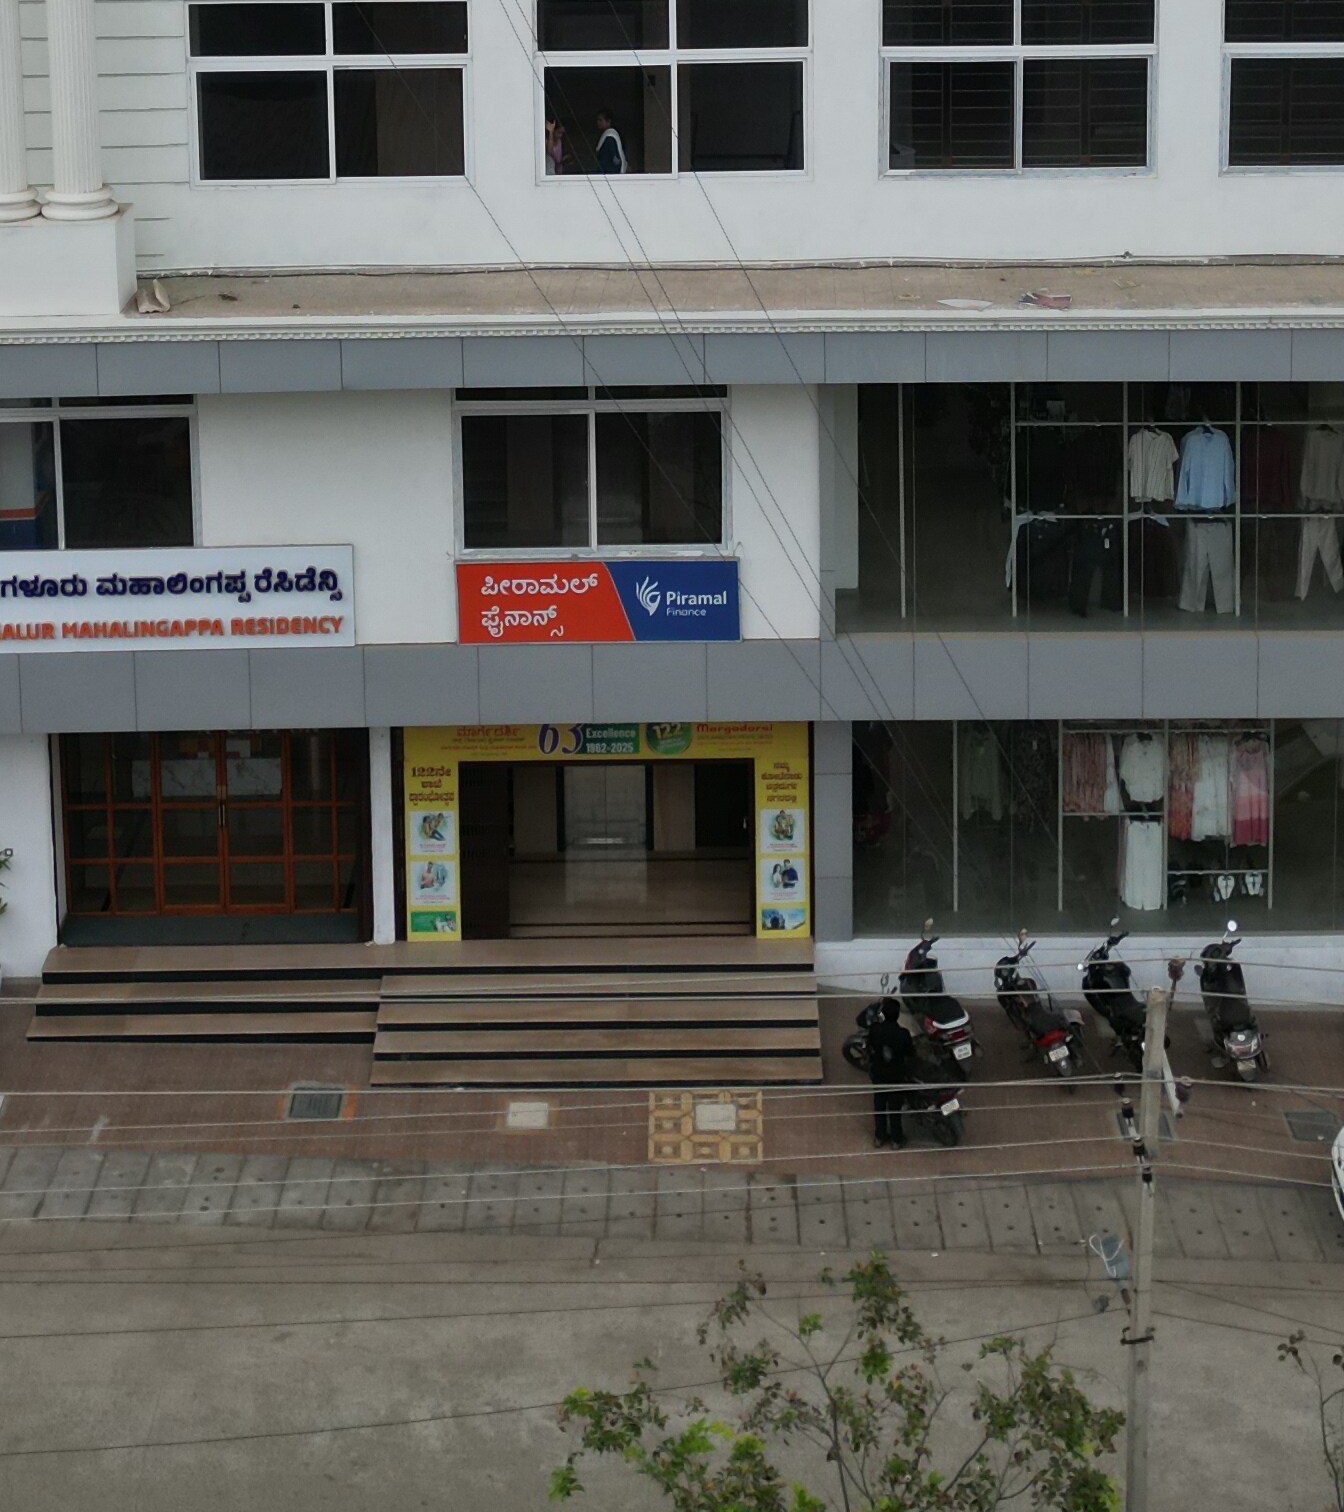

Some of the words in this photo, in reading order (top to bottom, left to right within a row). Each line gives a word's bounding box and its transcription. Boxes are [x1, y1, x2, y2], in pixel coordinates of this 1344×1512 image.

[95, 569, 252, 604] ಮಹಾಲಿಂಗಪ್ಪ
[666, 590, 728, 606] Piramal
[666, 607, 707, 617] Finance
[61, 618, 226, 639] MAHALINGAPPA
[230, 615, 345, 636] RESIDENCY
[585, 728, 637, 739] Excellence
